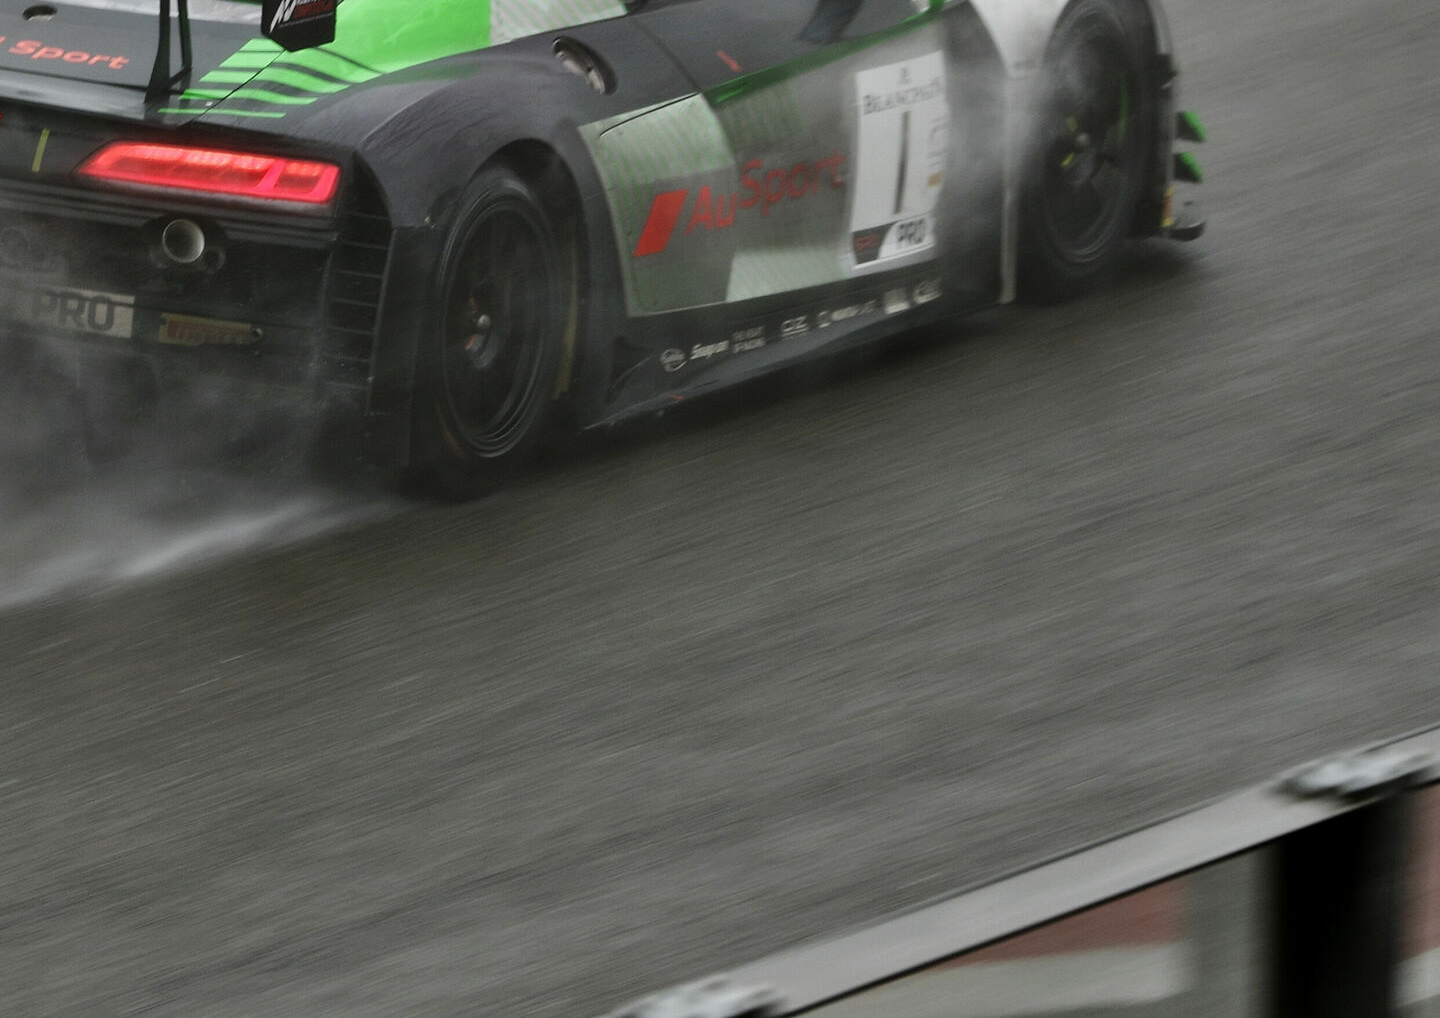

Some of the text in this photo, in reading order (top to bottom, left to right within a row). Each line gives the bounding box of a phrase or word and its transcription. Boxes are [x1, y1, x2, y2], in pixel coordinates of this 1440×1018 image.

[8, 40, 131, 70] Sport
[892, 110, 911, 216] 1
[896, 218, 927, 248] PRO
[32, 291, 118, 332] PRO
